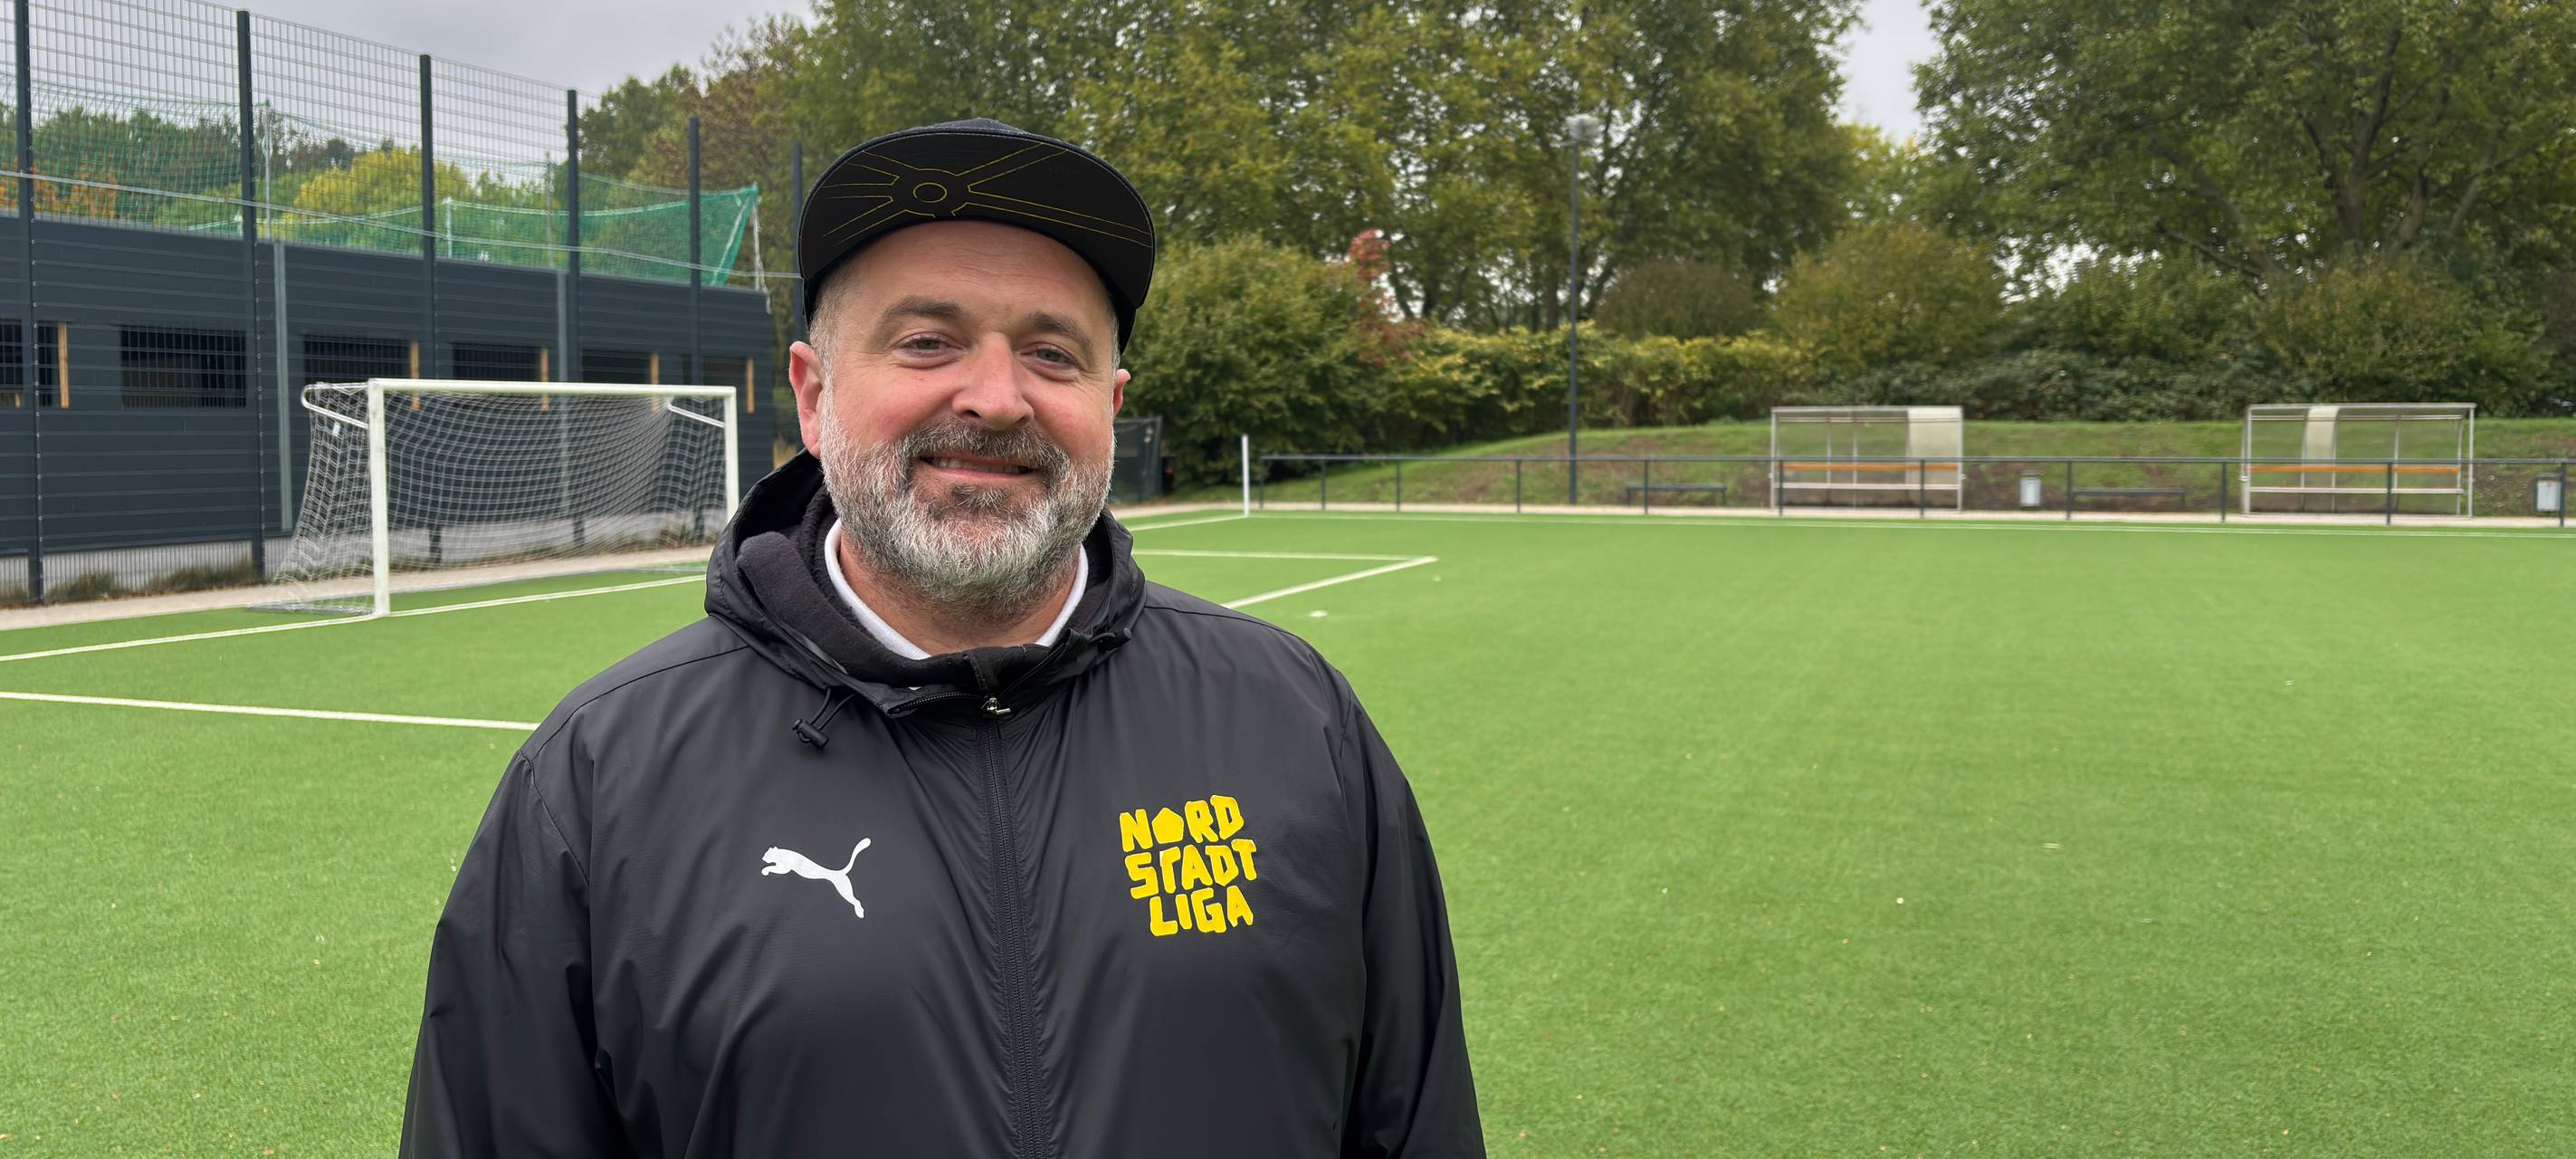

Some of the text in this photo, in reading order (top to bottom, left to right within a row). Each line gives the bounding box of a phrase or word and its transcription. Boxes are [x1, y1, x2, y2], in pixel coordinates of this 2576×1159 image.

[1120, 795, 1244, 852] NORD
[1125, 838, 1257, 899] STADT
[1150, 885, 1254, 937] LIGA
